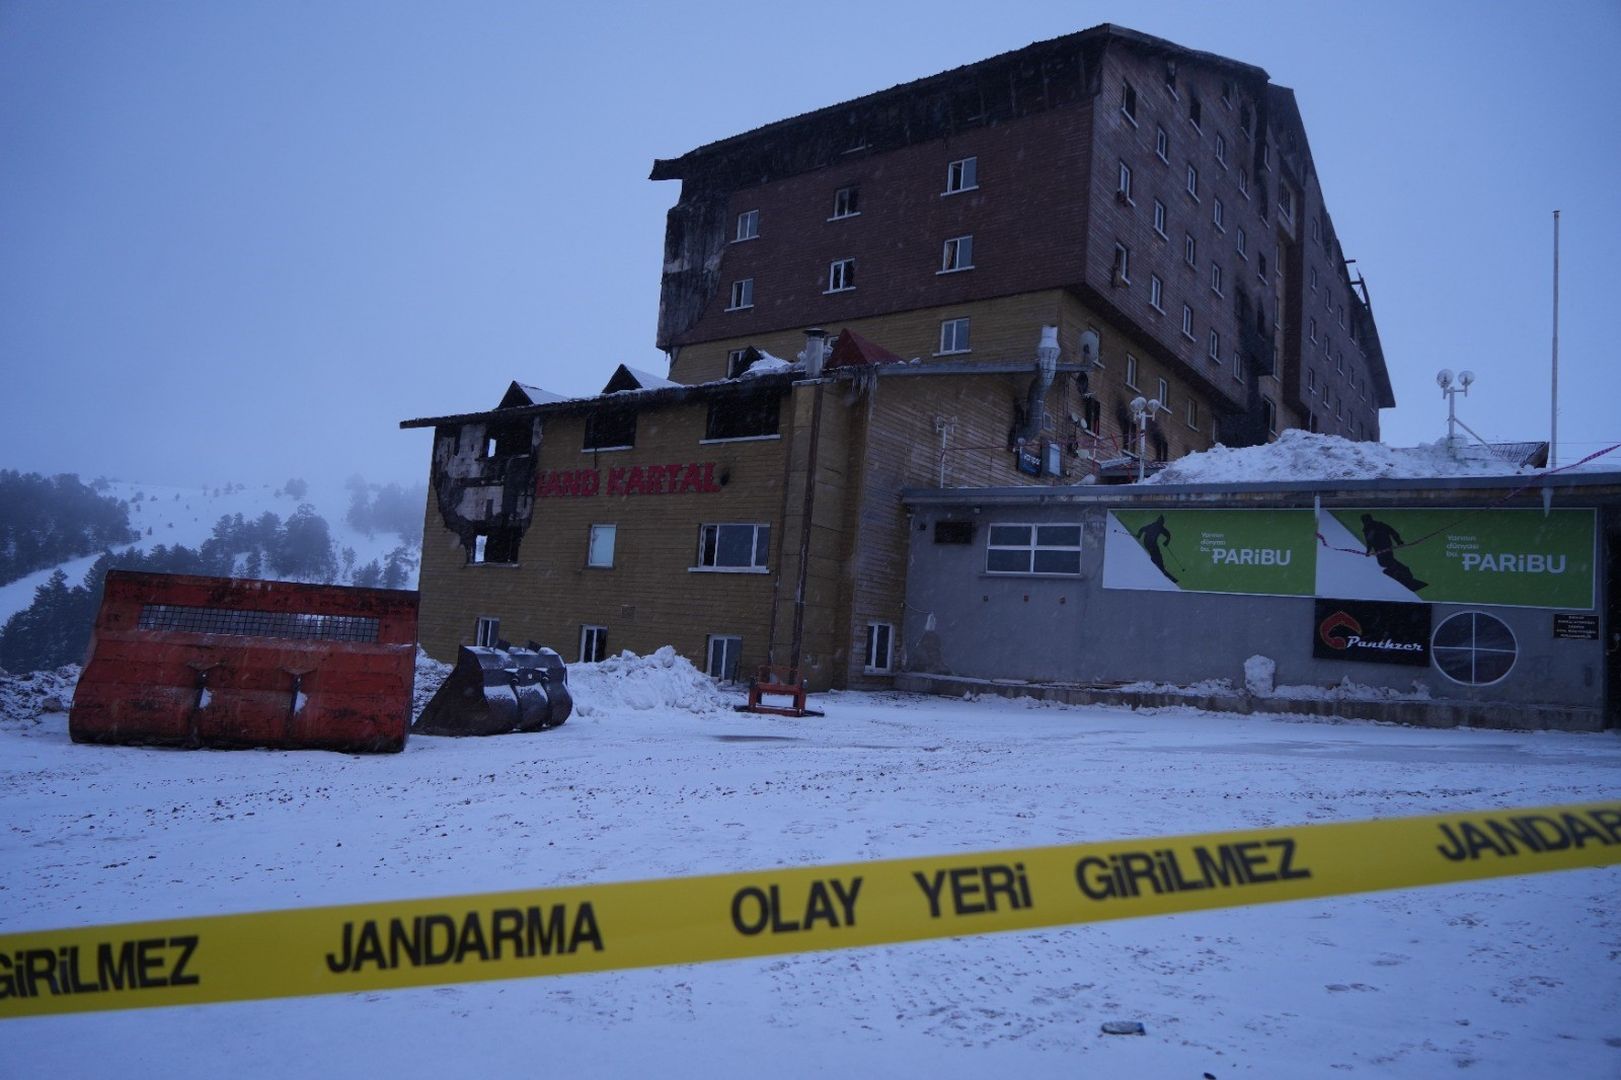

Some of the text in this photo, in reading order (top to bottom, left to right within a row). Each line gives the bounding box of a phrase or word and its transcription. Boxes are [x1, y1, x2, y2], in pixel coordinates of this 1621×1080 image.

[606, 461, 722, 497] KARTAL
[326, 902, 604, 974] JANDARMA
[730, 877, 864, 936] OLAY
